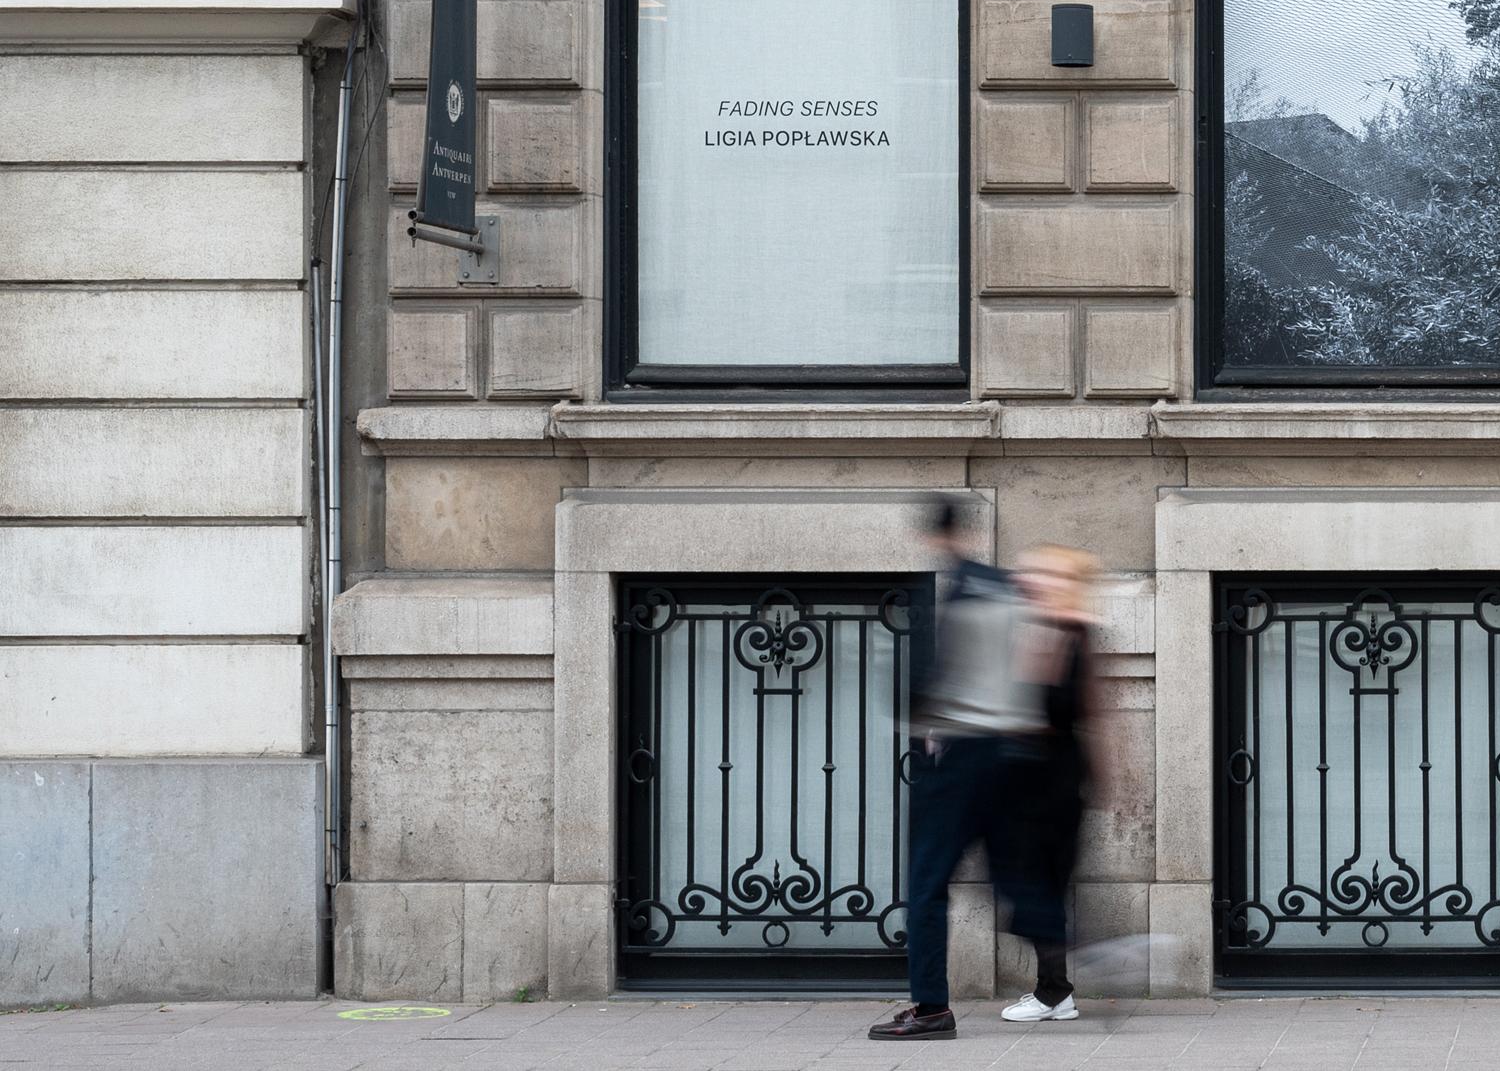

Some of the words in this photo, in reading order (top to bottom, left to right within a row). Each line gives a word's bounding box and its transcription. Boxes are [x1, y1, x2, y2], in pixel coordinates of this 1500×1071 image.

[718, 100, 794, 117] FADING
[800, 100, 878, 117] SENSES
[705, 130, 756, 146] LIGIA
[762, 130, 890, 146] POPŁAWSKA
